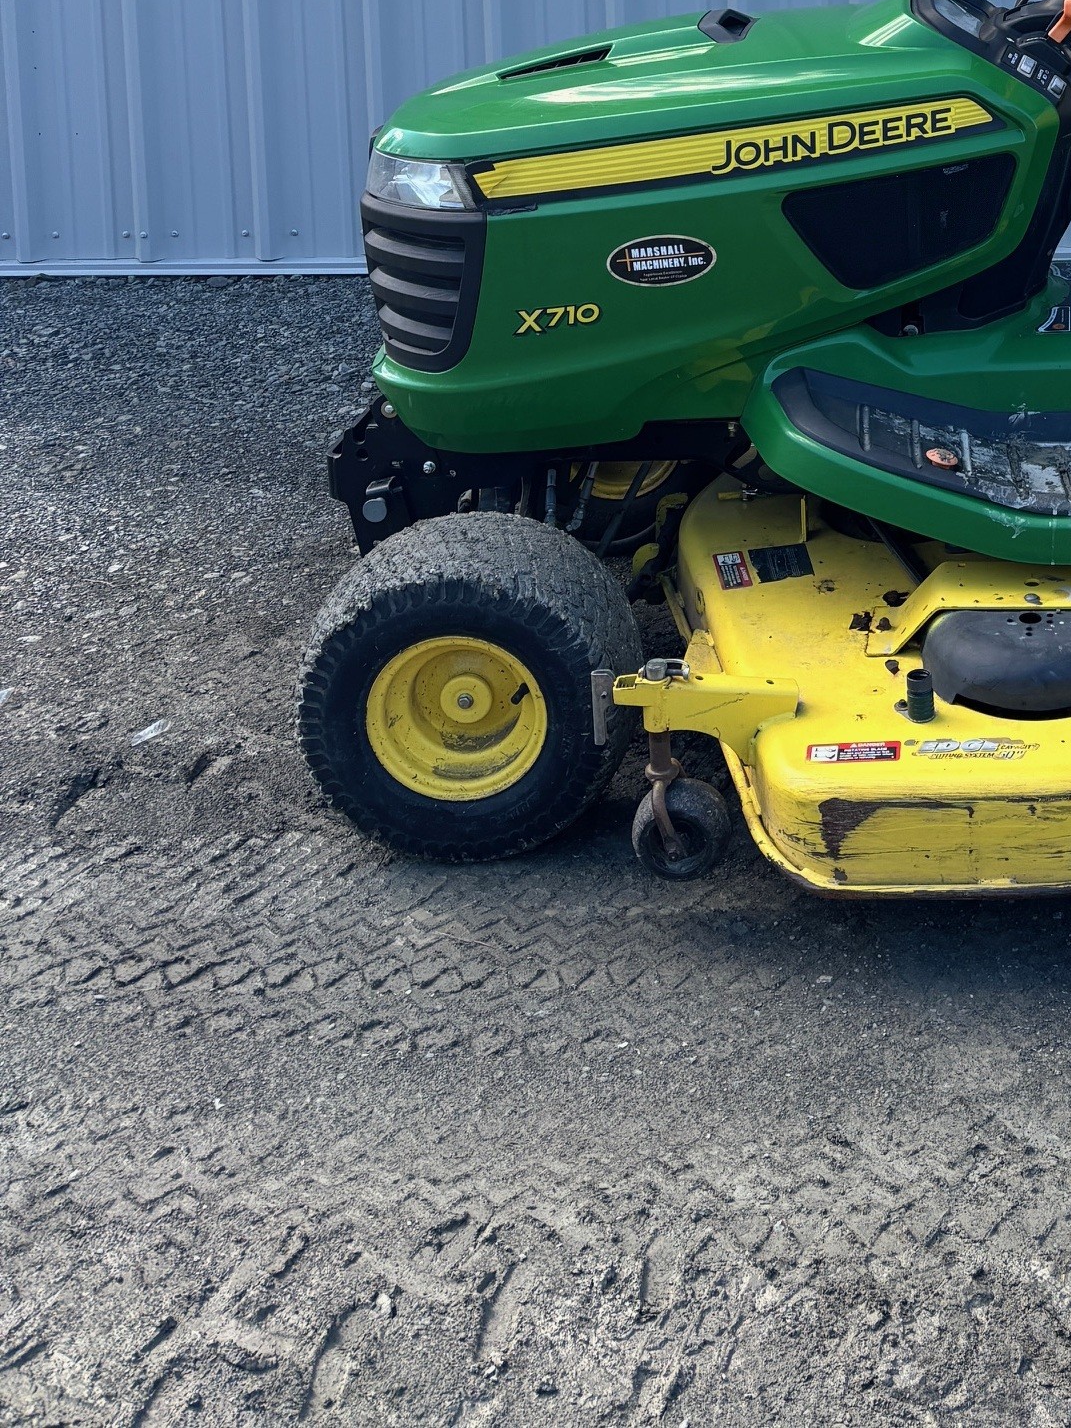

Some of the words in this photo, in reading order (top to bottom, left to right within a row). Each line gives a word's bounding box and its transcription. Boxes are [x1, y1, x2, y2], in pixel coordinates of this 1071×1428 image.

[711, 132, 817, 172] JOHN
[827, 108, 954, 154] DEERE
[631, 244, 685, 258] MARSHALL
[633, 257, 687, 271] MACHINERY,
[688, 256, 707, 266] Inc.
[513, 303, 602, 336] X710
[918, 739, 1000, 754] EDGE
